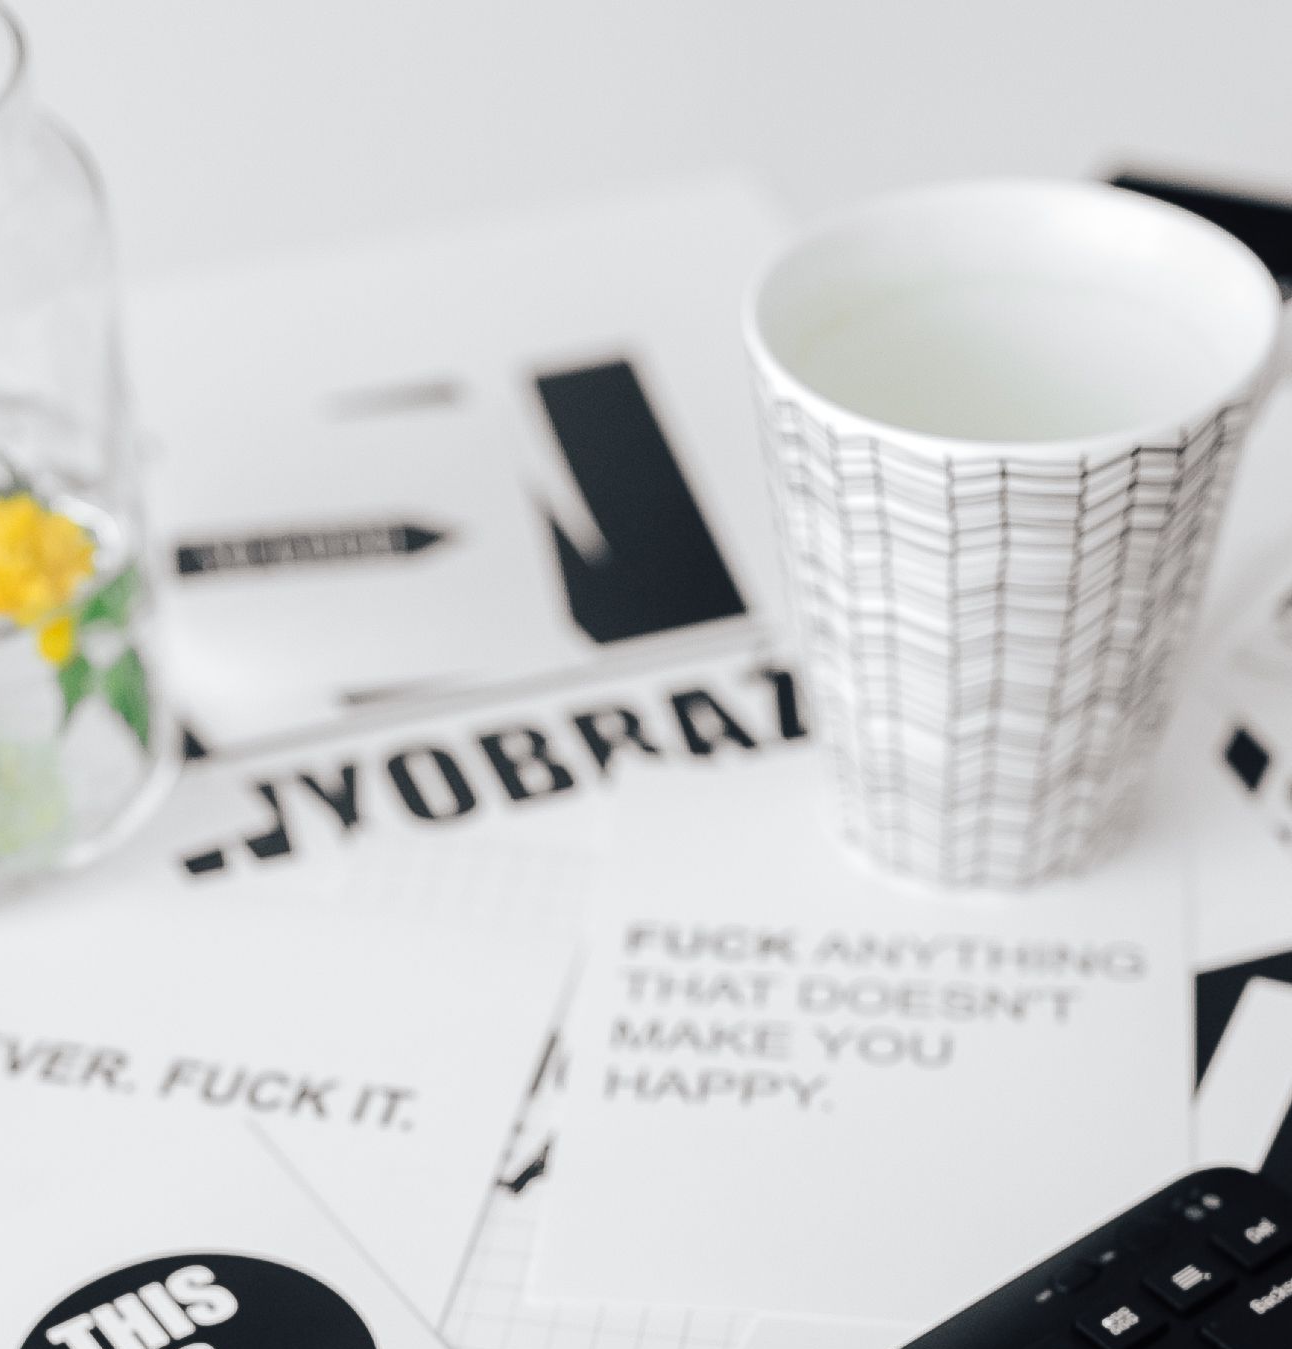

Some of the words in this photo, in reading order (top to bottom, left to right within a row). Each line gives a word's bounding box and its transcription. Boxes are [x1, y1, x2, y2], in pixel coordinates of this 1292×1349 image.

[622, 921, 800, 966] FUCK
[812, 930, 1151, 984] ANYTHING
[619, 967, 777, 1009] THAT
[797, 975, 1085, 1025] DOESN'T
[609, 1018, 791, 1059] MAKE
[815, 1024, 957, 1069] YOU
[159, 1056, 340, 1123] FUCK
[350, 1083, 419, 1133] IT.
[604, 1064, 836, 1114] HAPPY.
